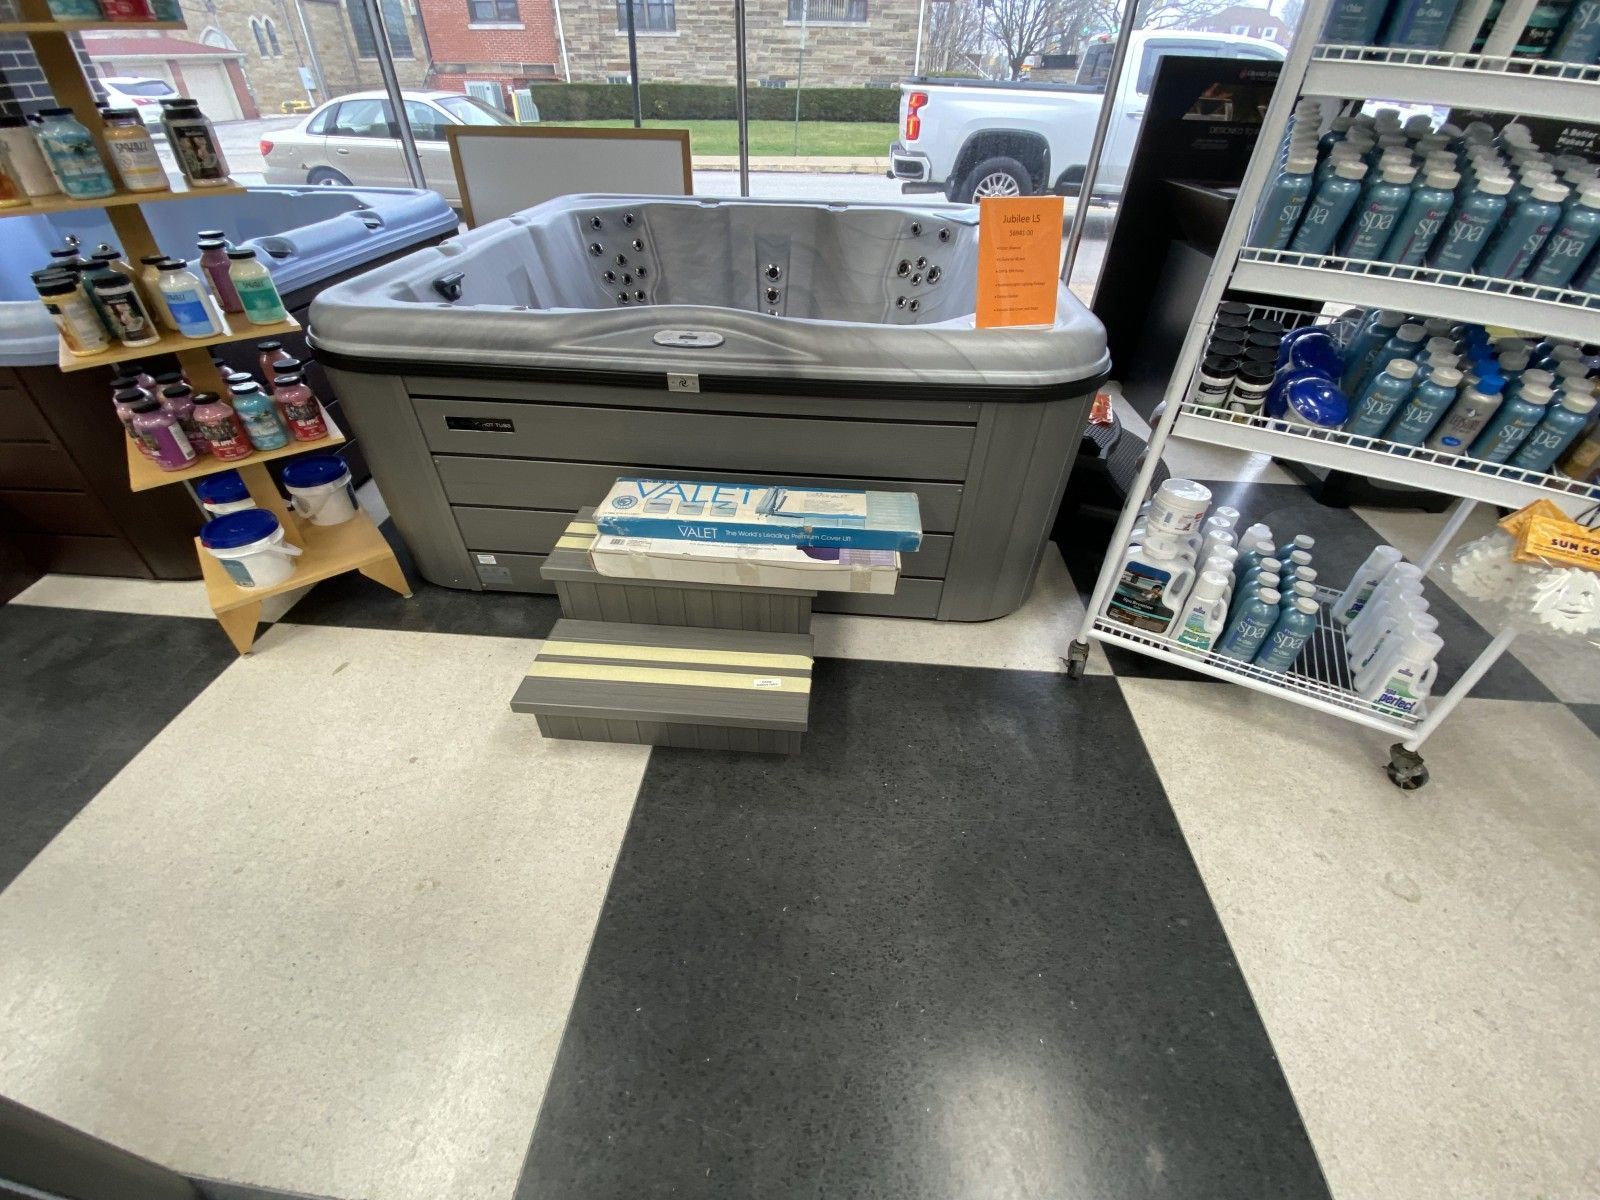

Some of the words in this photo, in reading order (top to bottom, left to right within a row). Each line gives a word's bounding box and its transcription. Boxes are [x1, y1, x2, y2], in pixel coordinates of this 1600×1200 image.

[1574, 1, 1600, 29] sp
[1002, 214, 1030, 224] Jubilee
[1279, 205, 1301, 225] sp
[1360, 210, 1395, 232] spa
[1414, 218, 1441, 240] sp
[1450, 220, 1486, 243] spa
[1548, 235, 1586, 258] spa
[1363, 396, 1394, 416] spa
[1405, 403, 1433, 424] spa
[636, 479, 758, 504] VALET
[677, 524, 718, 539] VALET
[738, 530, 762, 538] World's
[763, 531, 790, 540] Leading
[791, 532, 820, 541] Premium
[820, 534, 842, 542] Cover
[1551, 538, 1579, 551] SUN
[1238, 621, 1266, 639] spa
[1273, 631, 1305, 649] spa
[1377, 693, 1417, 711] perfect
